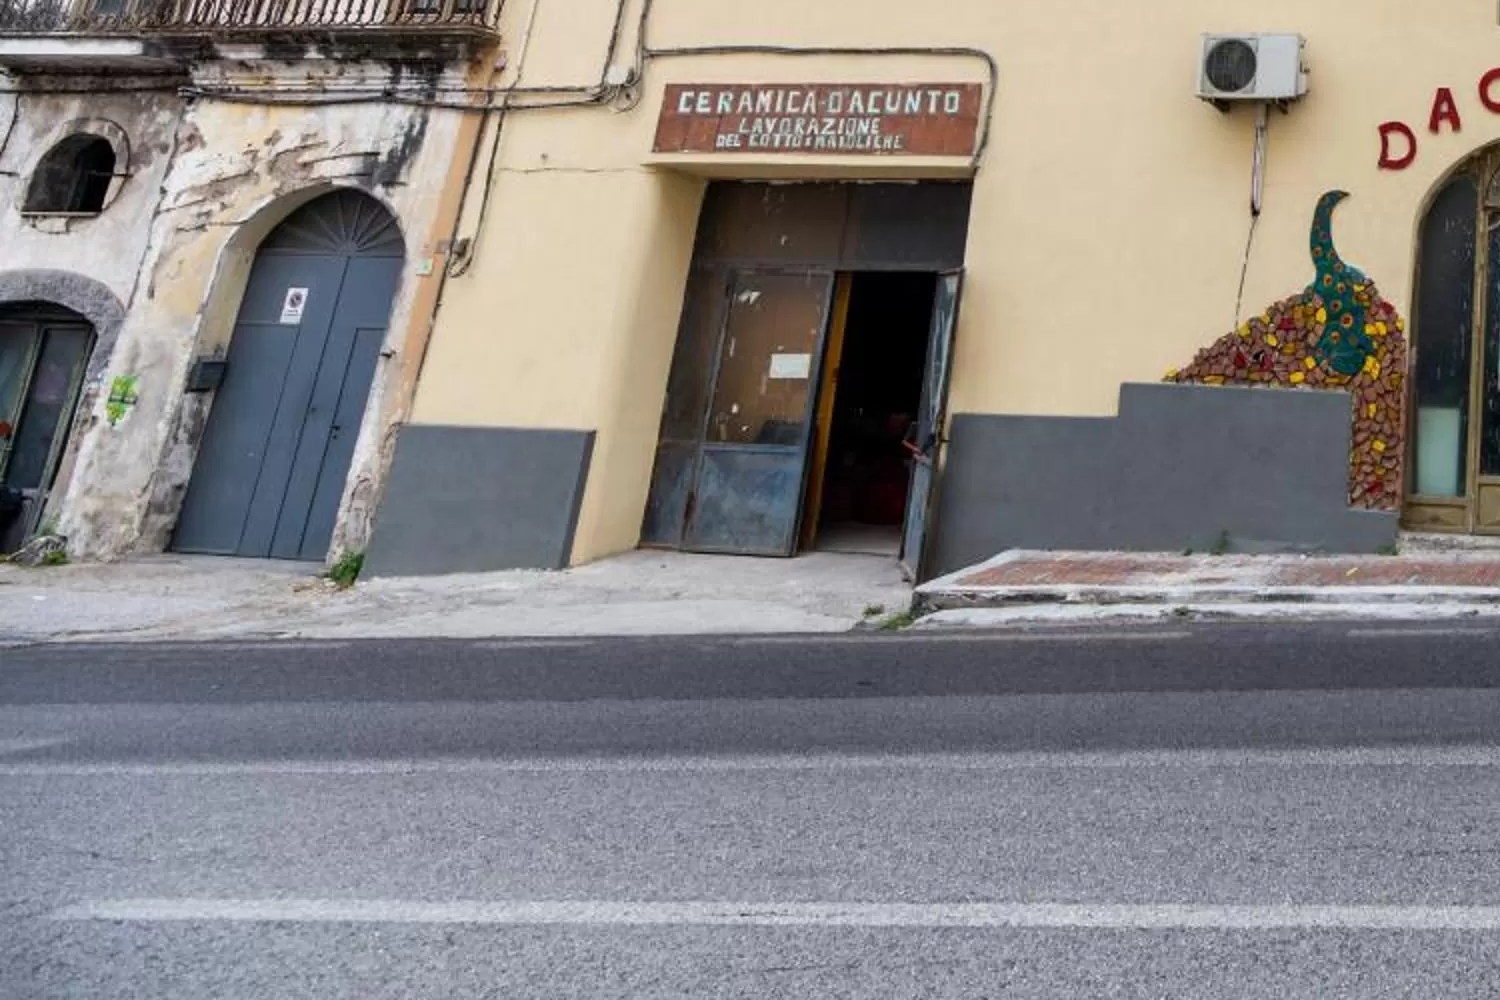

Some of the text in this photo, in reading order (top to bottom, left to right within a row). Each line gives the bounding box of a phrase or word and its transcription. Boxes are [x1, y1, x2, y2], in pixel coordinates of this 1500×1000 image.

[739, 117, 881, 134] LAVORAZIONE
[716, 134, 741, 147] DEL
[749, 134, 801, 148] COTTO
